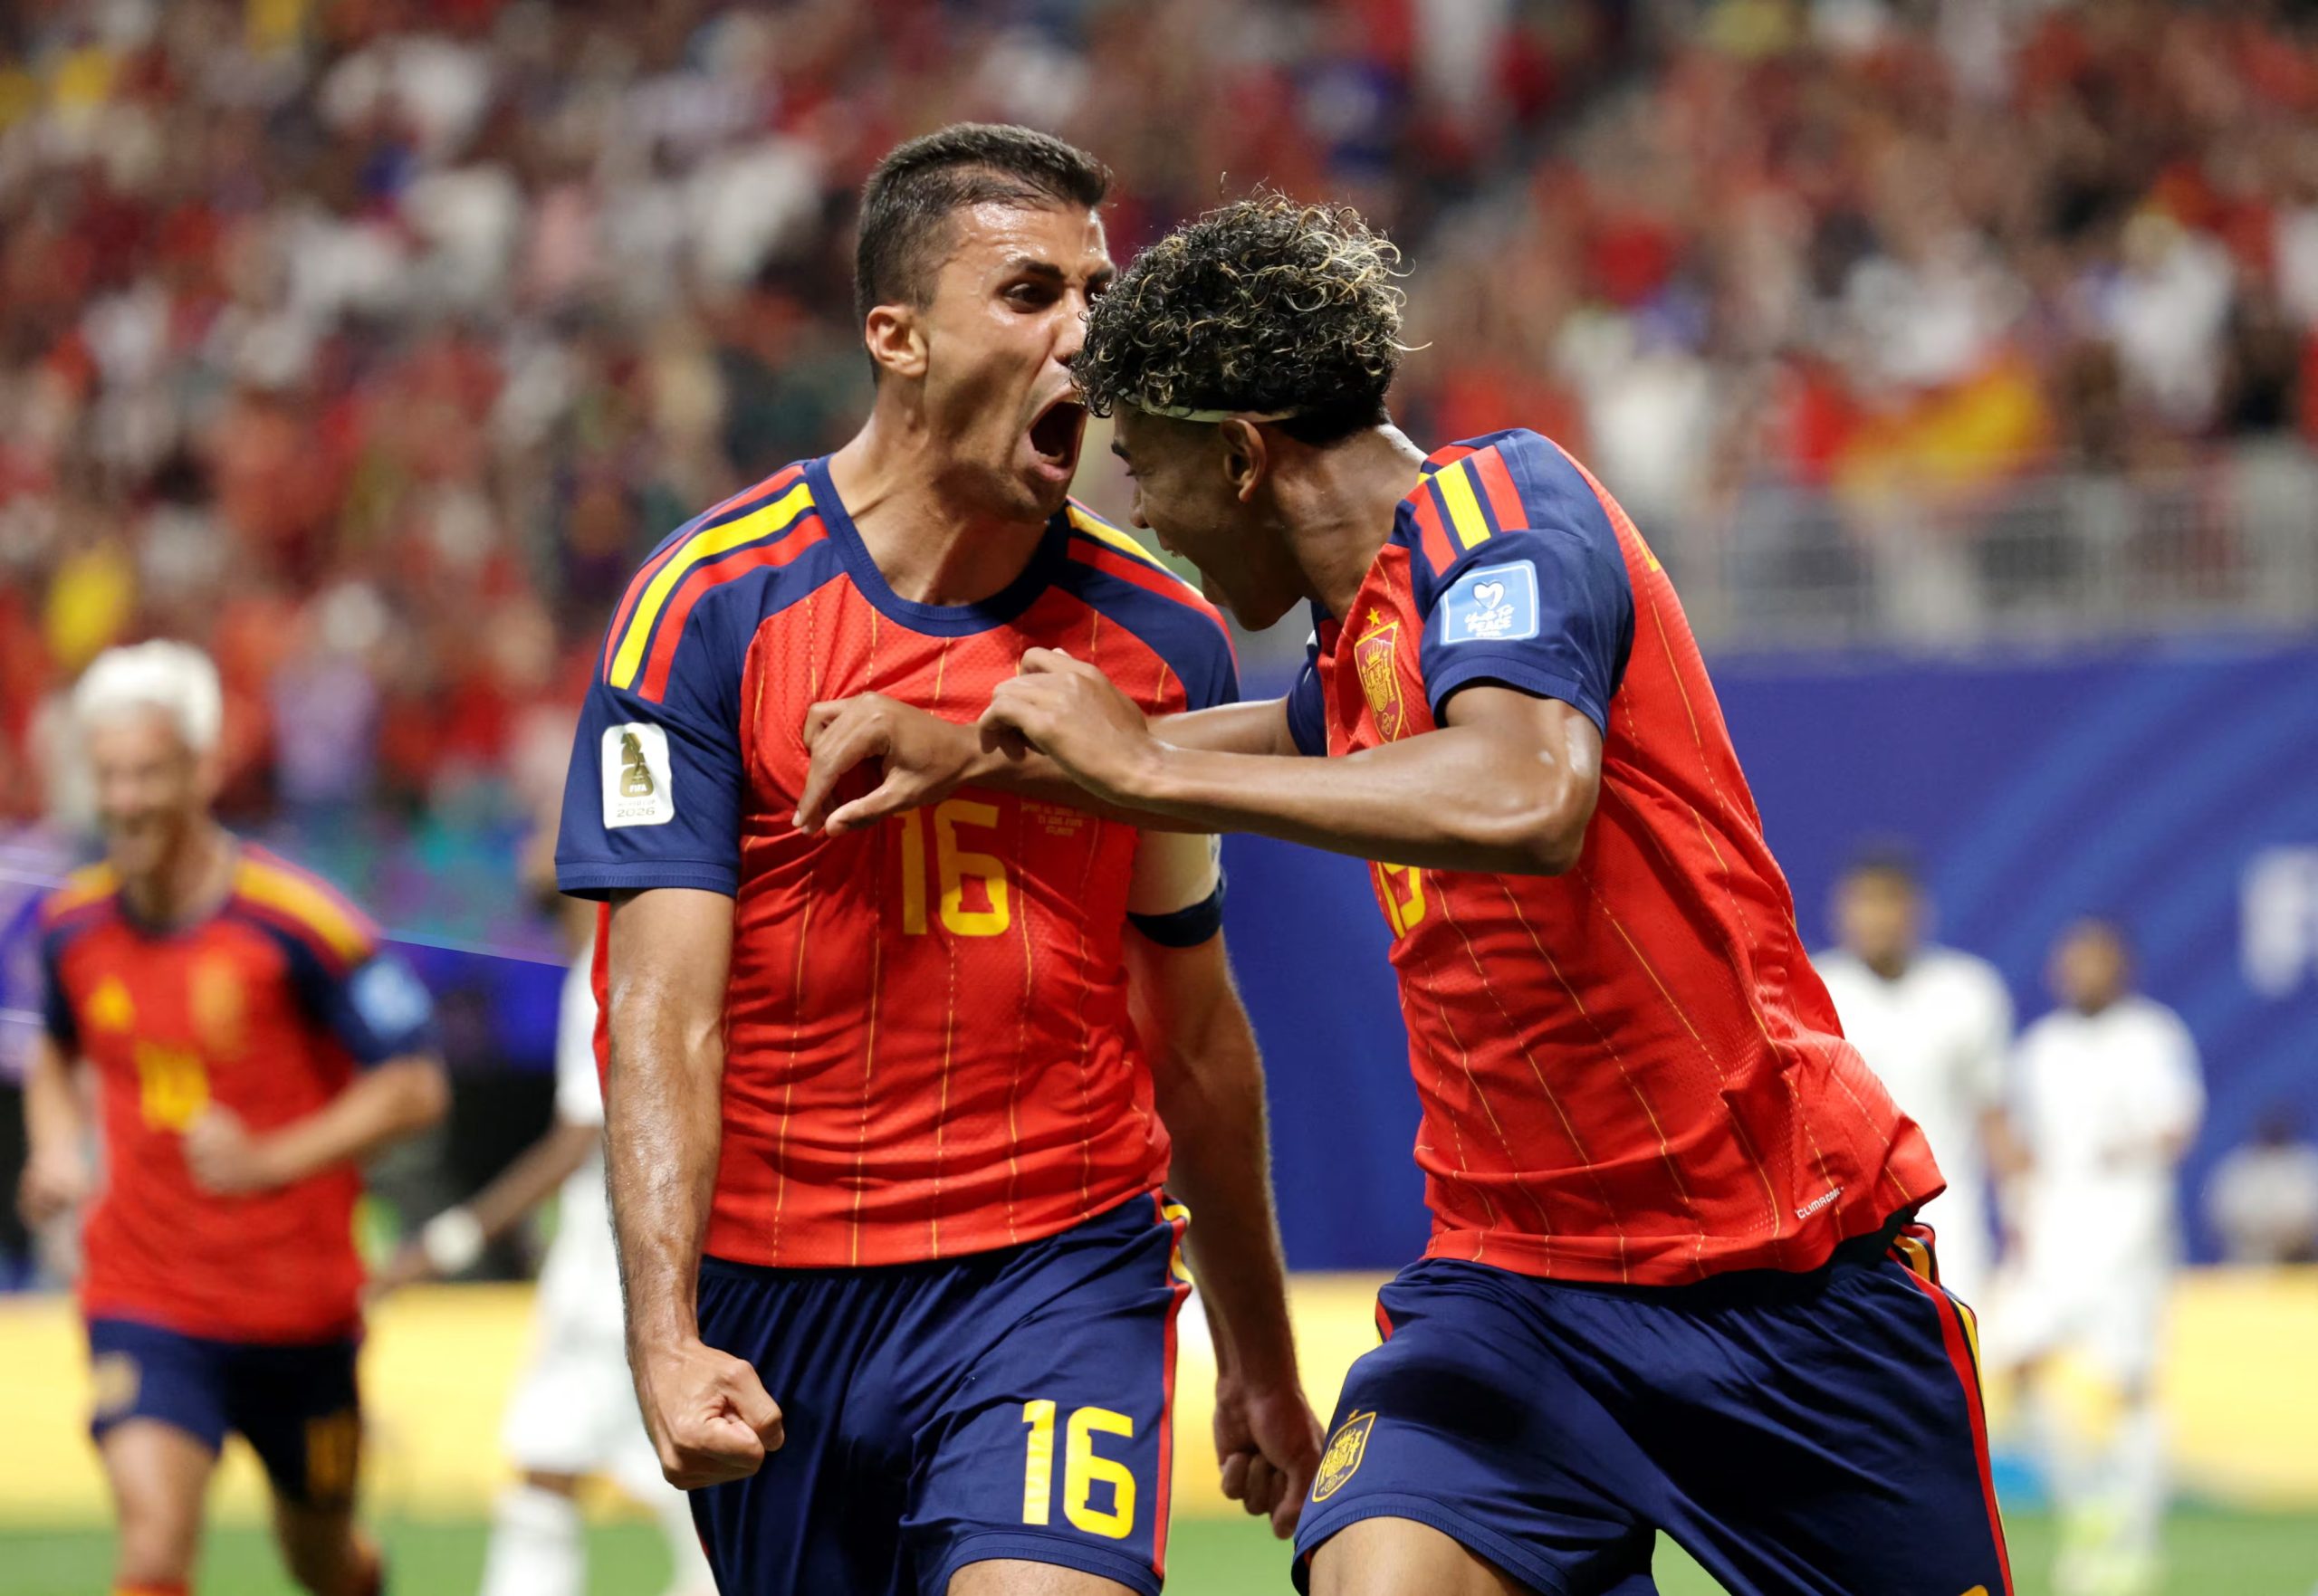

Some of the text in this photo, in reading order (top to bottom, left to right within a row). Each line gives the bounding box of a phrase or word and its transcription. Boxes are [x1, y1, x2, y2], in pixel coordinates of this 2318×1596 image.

[616, 807, 656, 817] 2026
[893, 798, 1011, 937] 16
[1022, 1400, 1136, 1539] 16
